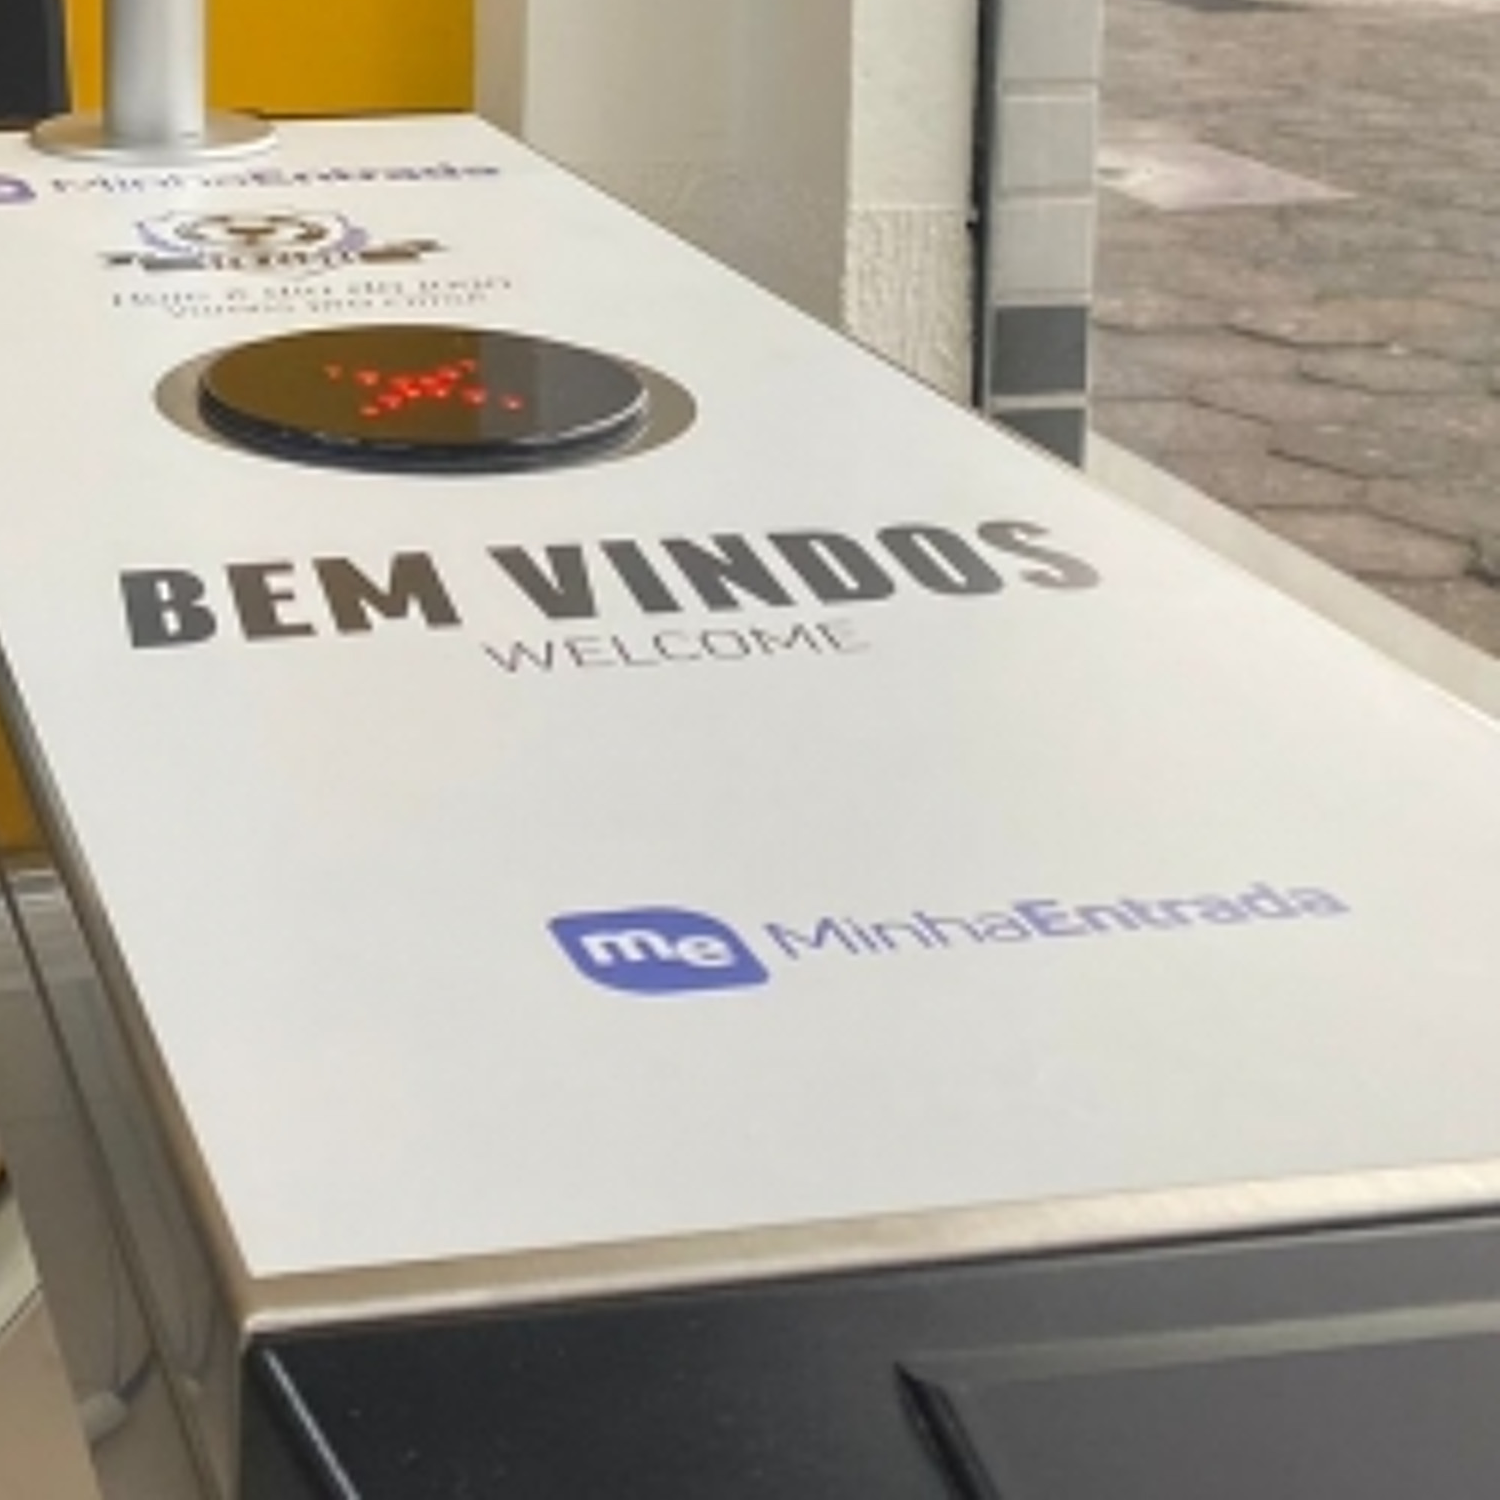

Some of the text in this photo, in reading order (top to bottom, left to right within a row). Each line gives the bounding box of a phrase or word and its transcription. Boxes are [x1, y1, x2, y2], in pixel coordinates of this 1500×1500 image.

[118, 520, 1101, 650] BEM VINDOS
[481, 617, 872, 675] WELCOME
[579, 881, 1350, 970] me MinhaEntrada
